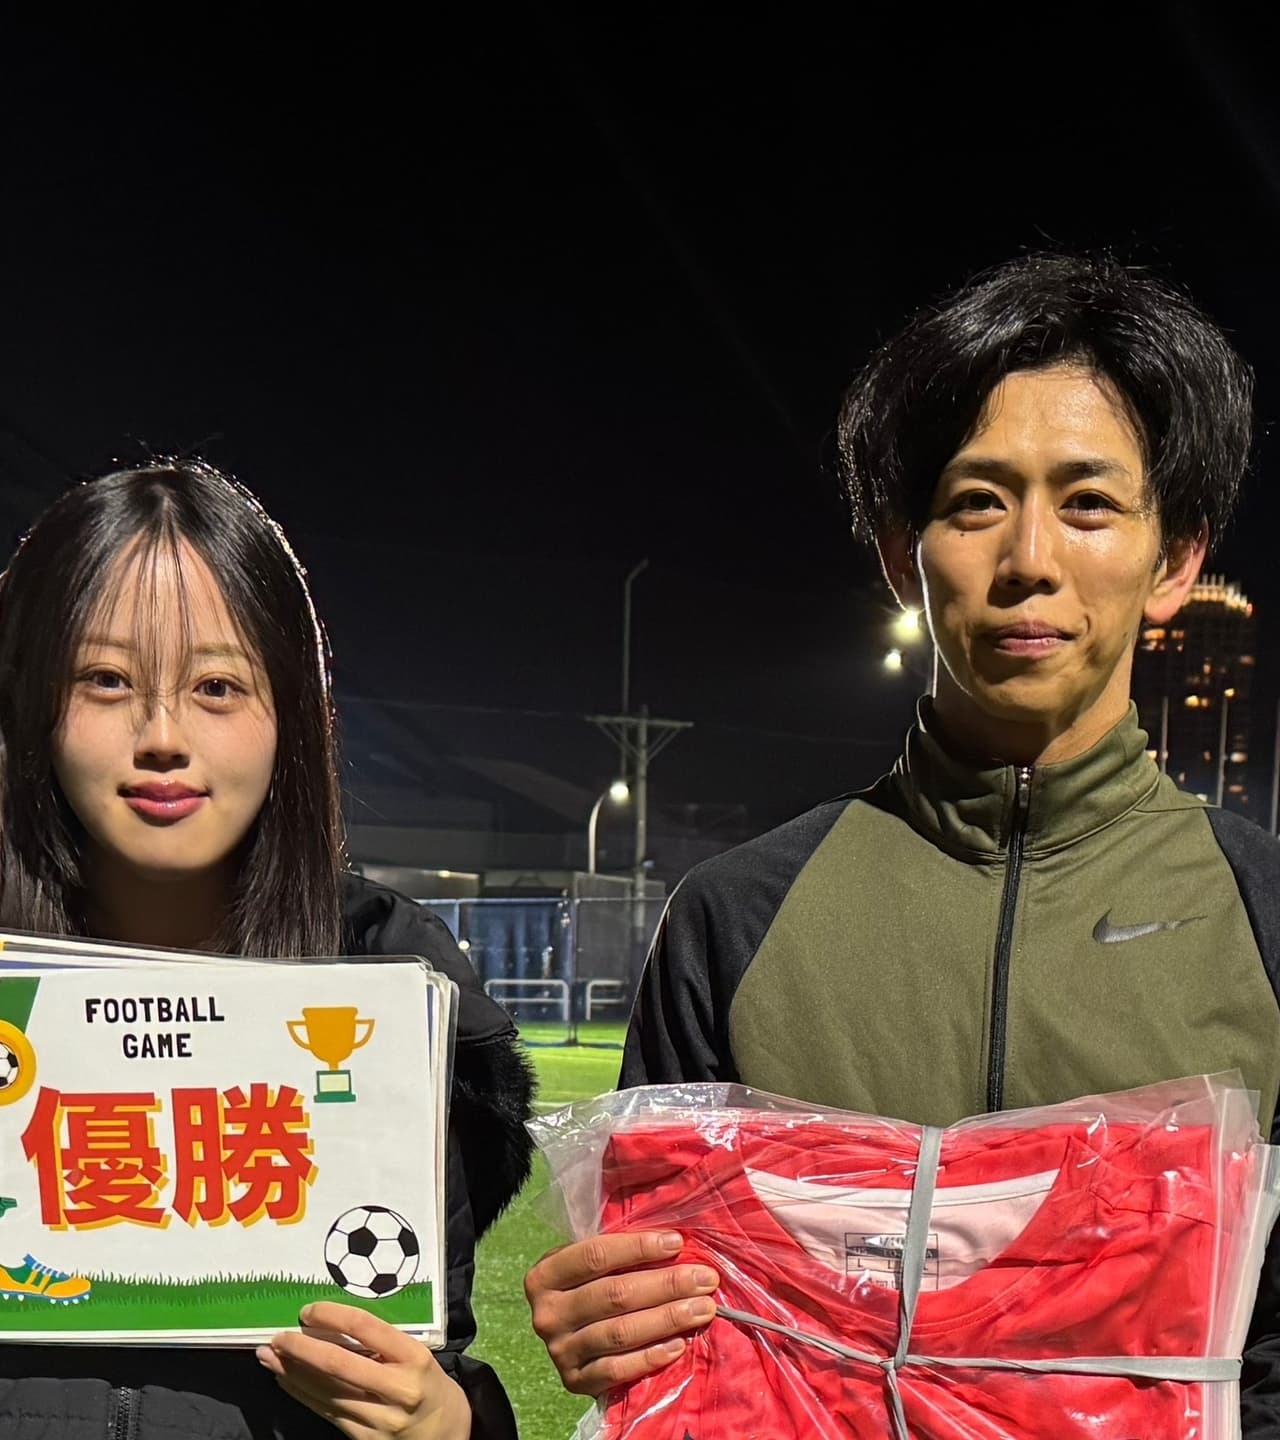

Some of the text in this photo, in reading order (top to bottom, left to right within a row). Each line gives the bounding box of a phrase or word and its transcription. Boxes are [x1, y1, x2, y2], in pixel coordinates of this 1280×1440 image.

[85, 996, 225, 1023] FOOTBALL
[122, 1033, 192, 1059] GAME
[21, 1082, 319, 1231] 優勝
